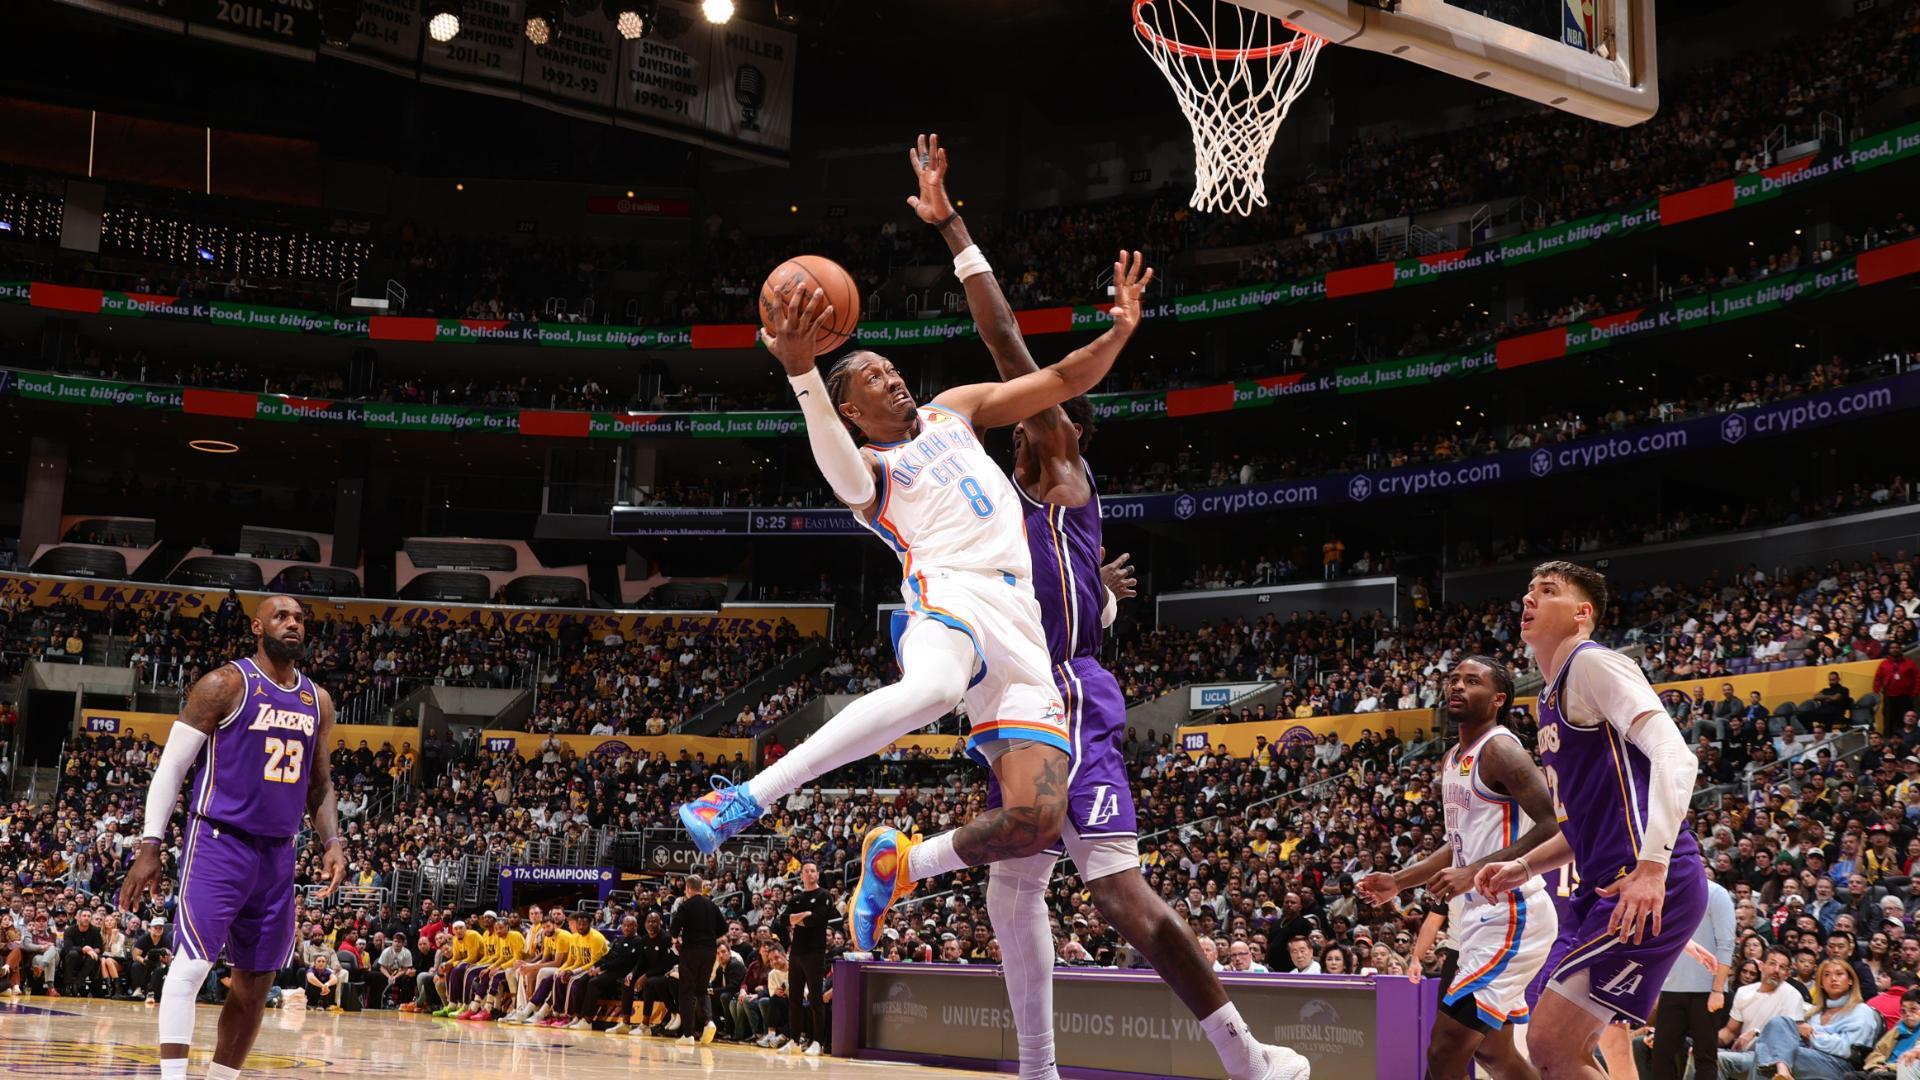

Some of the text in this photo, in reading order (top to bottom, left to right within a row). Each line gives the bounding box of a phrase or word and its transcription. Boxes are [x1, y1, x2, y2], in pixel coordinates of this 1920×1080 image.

[216, 1, 294, 36] 2011-12
[356, 3, 411, 26] MPIONS
[355, 19, 399, 45] 13-14
[460, 27, 515, 49] MPIONS
[1567, 27, 1583, 47] NBA
[446, 44, 502, 68] 2011-12
[642, 41, 689, 64] SMYTHE
[725, 31, 784, 61] MILLER
[542, 66, 598, 94] 1992-93
[639, 56, 691, 79] DIVISION
[628, 69, 699, 97] CHAMPIONS
[635, 89, 689, 115] 1990-91
[1733, 185, 1757, 199] For
[1762, 160, 1829, 191] Delicious
[1833, 140, 1893, 170] K-Food,
[1394, 268, 1415, 280] For
[1420, 257, 1481, 275] Delicious
[1485, 237, 1535, 263] K-Food,
[1538, 235, 1563, 251] Just
[1622, 215, 1642, 227] for
[1160, 301, 1209, 316] K-Food,
[1213, 298, 1236, 311] Just
[1291, 285, 1310, 296] for
[1565, 333, 1587, 346] For
[1591, 319, 1655, 341] Delicious
[1659, 296, 1720, 326] K-Food,
[1724, 296, 1752, 314] Just
[1816, 274, 1838, 288] for
[102, 297, 123, 308] For
[127, 299, 189, 315] Delicious
[193, 306, 245, 322] K-Food,
[249, 312, 275, 323] Just
[334, 320, 353, 331] for
[1072, 313, 1092, 324] For
[436, 325, 456, 335] For
[461, 326, 519, 338] Delicious
[523, 329, 573, 342] K-Food,
[577, 331, 602, 342] Just
[658, 333, 676, 343] for
[895, 328, 919, 339] Just
[1233, 390, 1254, 401] For
[1257, 382, 1316, 398] Delicious
[1320, 372, 1372, 389] K-Food,
[1376, 370, 1402, 383] Just
[1462, 357, 1480, 369] for
[58, 384, 86, 396] Just
[146, 392, 166, 403] for
[256, 402, 277, 413] For
[282, 404, 343, 419] Delicious
[347, 410, 398, 424] K-Food,
[402, 412, 427, 424] Just
[484, 416, 503, 426] for
[1131, 401, 1151, 412] for
[1753, 386, 1892, 433] crypto.com
[589, 420, 610, 431] For
[614, 421, 671, 432] Delicious
[675, 421, 724, 432] K-Food,
[727, 420, 752, 432] Just
[1559, 427, 1687, 471] crypto.com
[1378, 463, 1501, 493] crypto.com
[957, 475, 997, 519] 8
[1202, 485, 1317, 513] crypto.com
[755, 516, 786, 529] 9:25
[48, 581, 206, 608] LAKERS
[380, 607, 452, 626] LOS
[1205, 693, 1228, 702] UCLA
[92, 719, 115, 732] 116
[248, 702, 315, 737] LAKERS
[491, 739, 510, 751] 117
[1186, 735, 1204, 749] 118
[264, 736, 305, 784] 23
[514, 868, 599, 881] 17x CHAMPIONS
[1053, 1011, 1115, 1037] TUDIOS
[1121, 1014, 1205, 1042] HOLLYW
[1274, 1024, 1365, 1048] UNIVERSAL STUDIOS
